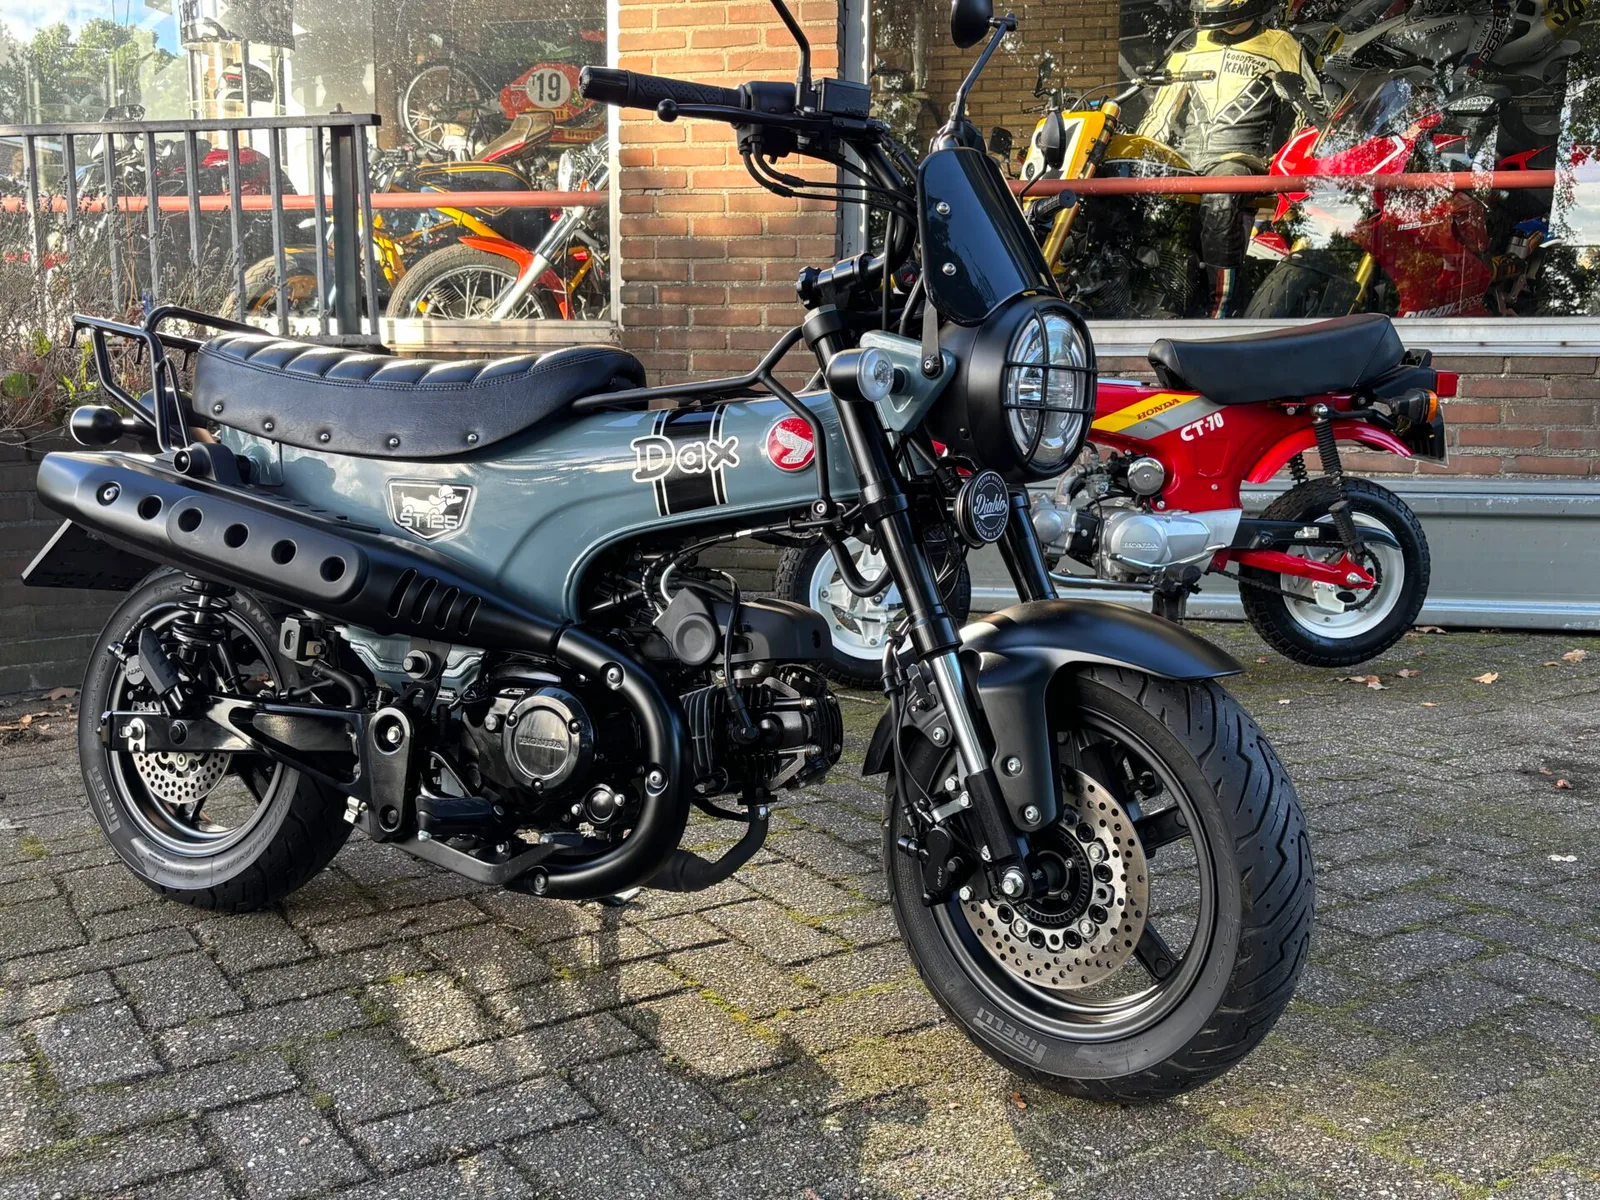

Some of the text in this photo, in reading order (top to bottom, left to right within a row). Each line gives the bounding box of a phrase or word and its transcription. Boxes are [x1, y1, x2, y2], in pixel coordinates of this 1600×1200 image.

[1424, 19, 1458, 36] SUZUKI
[1479, 16, 1506, 64] PEPS
[1223, 60, 1259, 77] KENNY
[1226, 52, 1267, 68] GOODYEAR
[1136, 398, 1181, 421] HONDA
[630, 435, 739, 482] Dax
[973, 493, 1008, 517] Diablo
[400, 512, 458, 530] ST125
[518, 736, 566, 751] HONDA
[87, 766, 121, 834] PIRELLI
[972, 1007, 1048, 1064] PIRELLI
